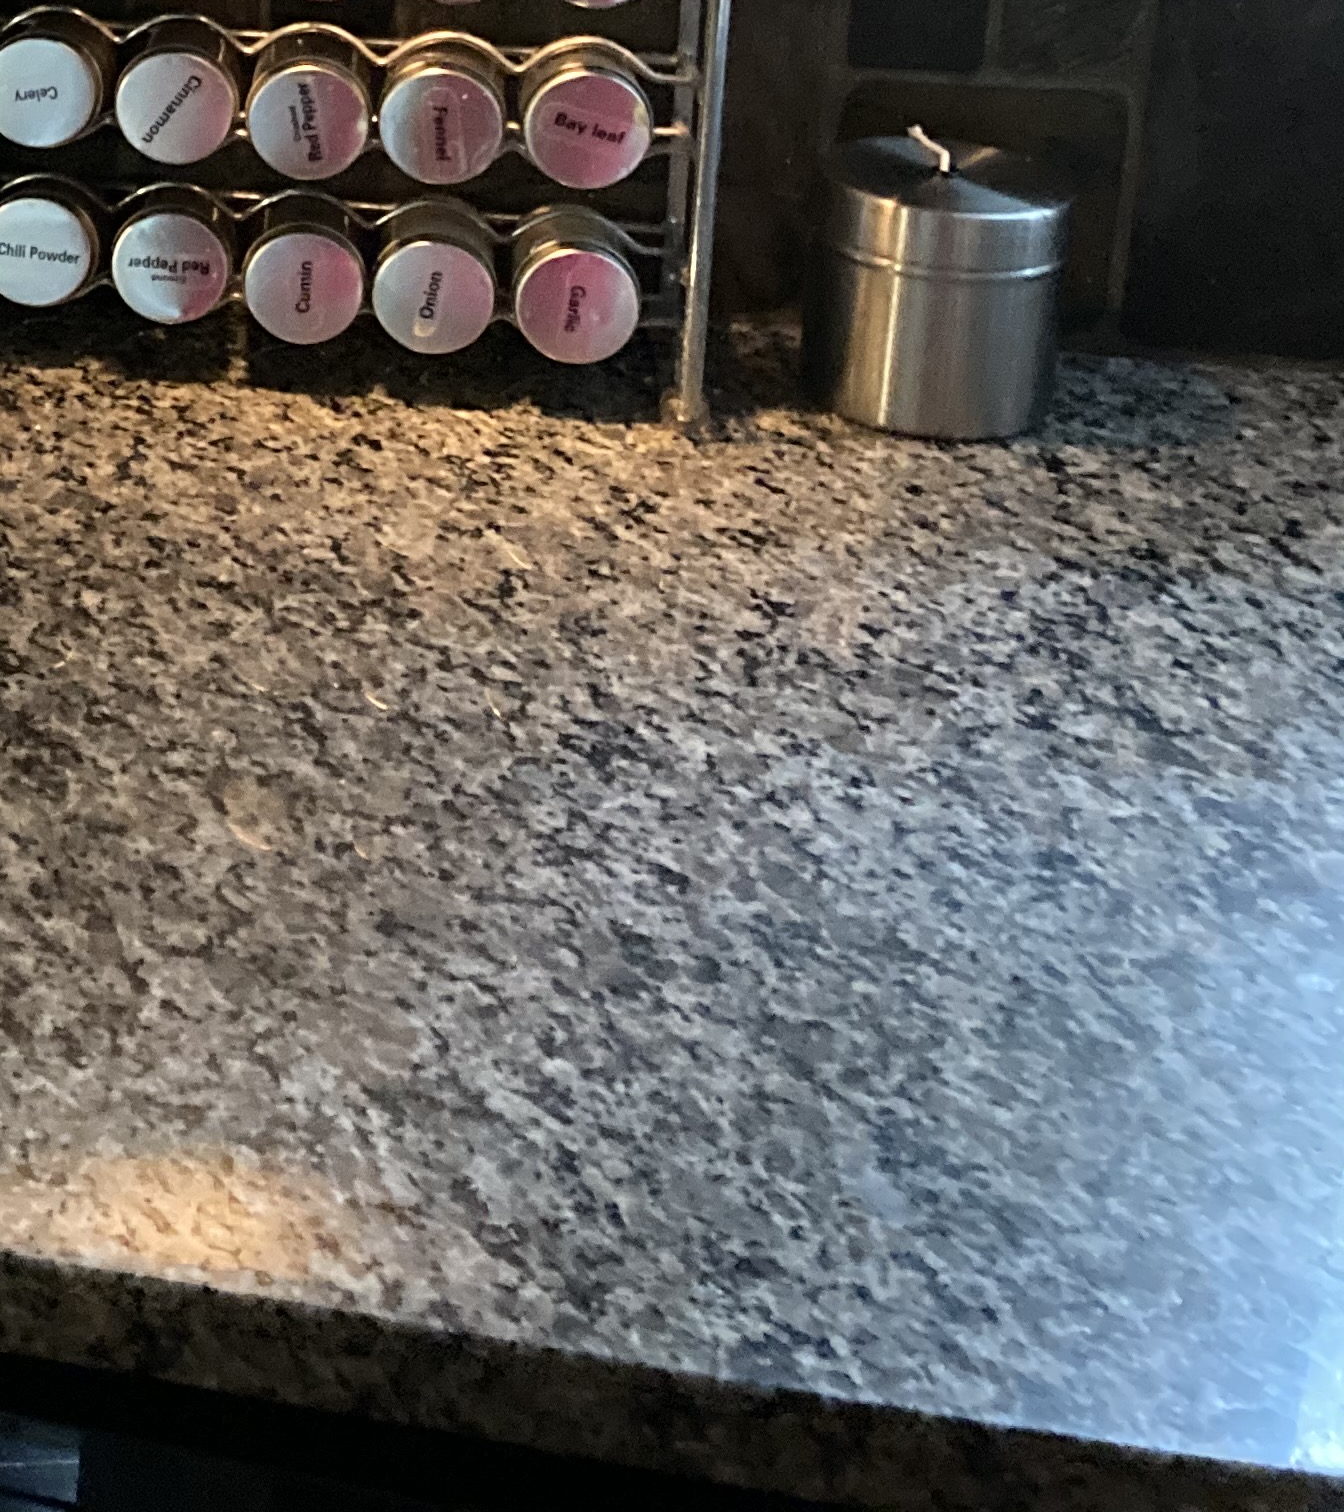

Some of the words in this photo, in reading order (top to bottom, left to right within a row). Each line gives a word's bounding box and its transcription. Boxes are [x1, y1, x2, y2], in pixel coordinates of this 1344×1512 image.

[14, 85, 58, 103] Celery
[141, 74, 203, 145] Cinnamon
[298, 82, 319, 128] Pepper
[307, 128, 324, 163] Red
[432, 106, 451, 162] Fennel
[554, 111, 586, 137] Bay
[591, 122, 626, 146] leaf
[29, 247, 81, 265] Powder
[128, 256, 178, 274] Pepper
[182, 261, 210, 276] Red
[294, 260, 313, 313] Cumin
[419, 270, 443, 320] Onion
[564, 286, 587, 333] Garlic
